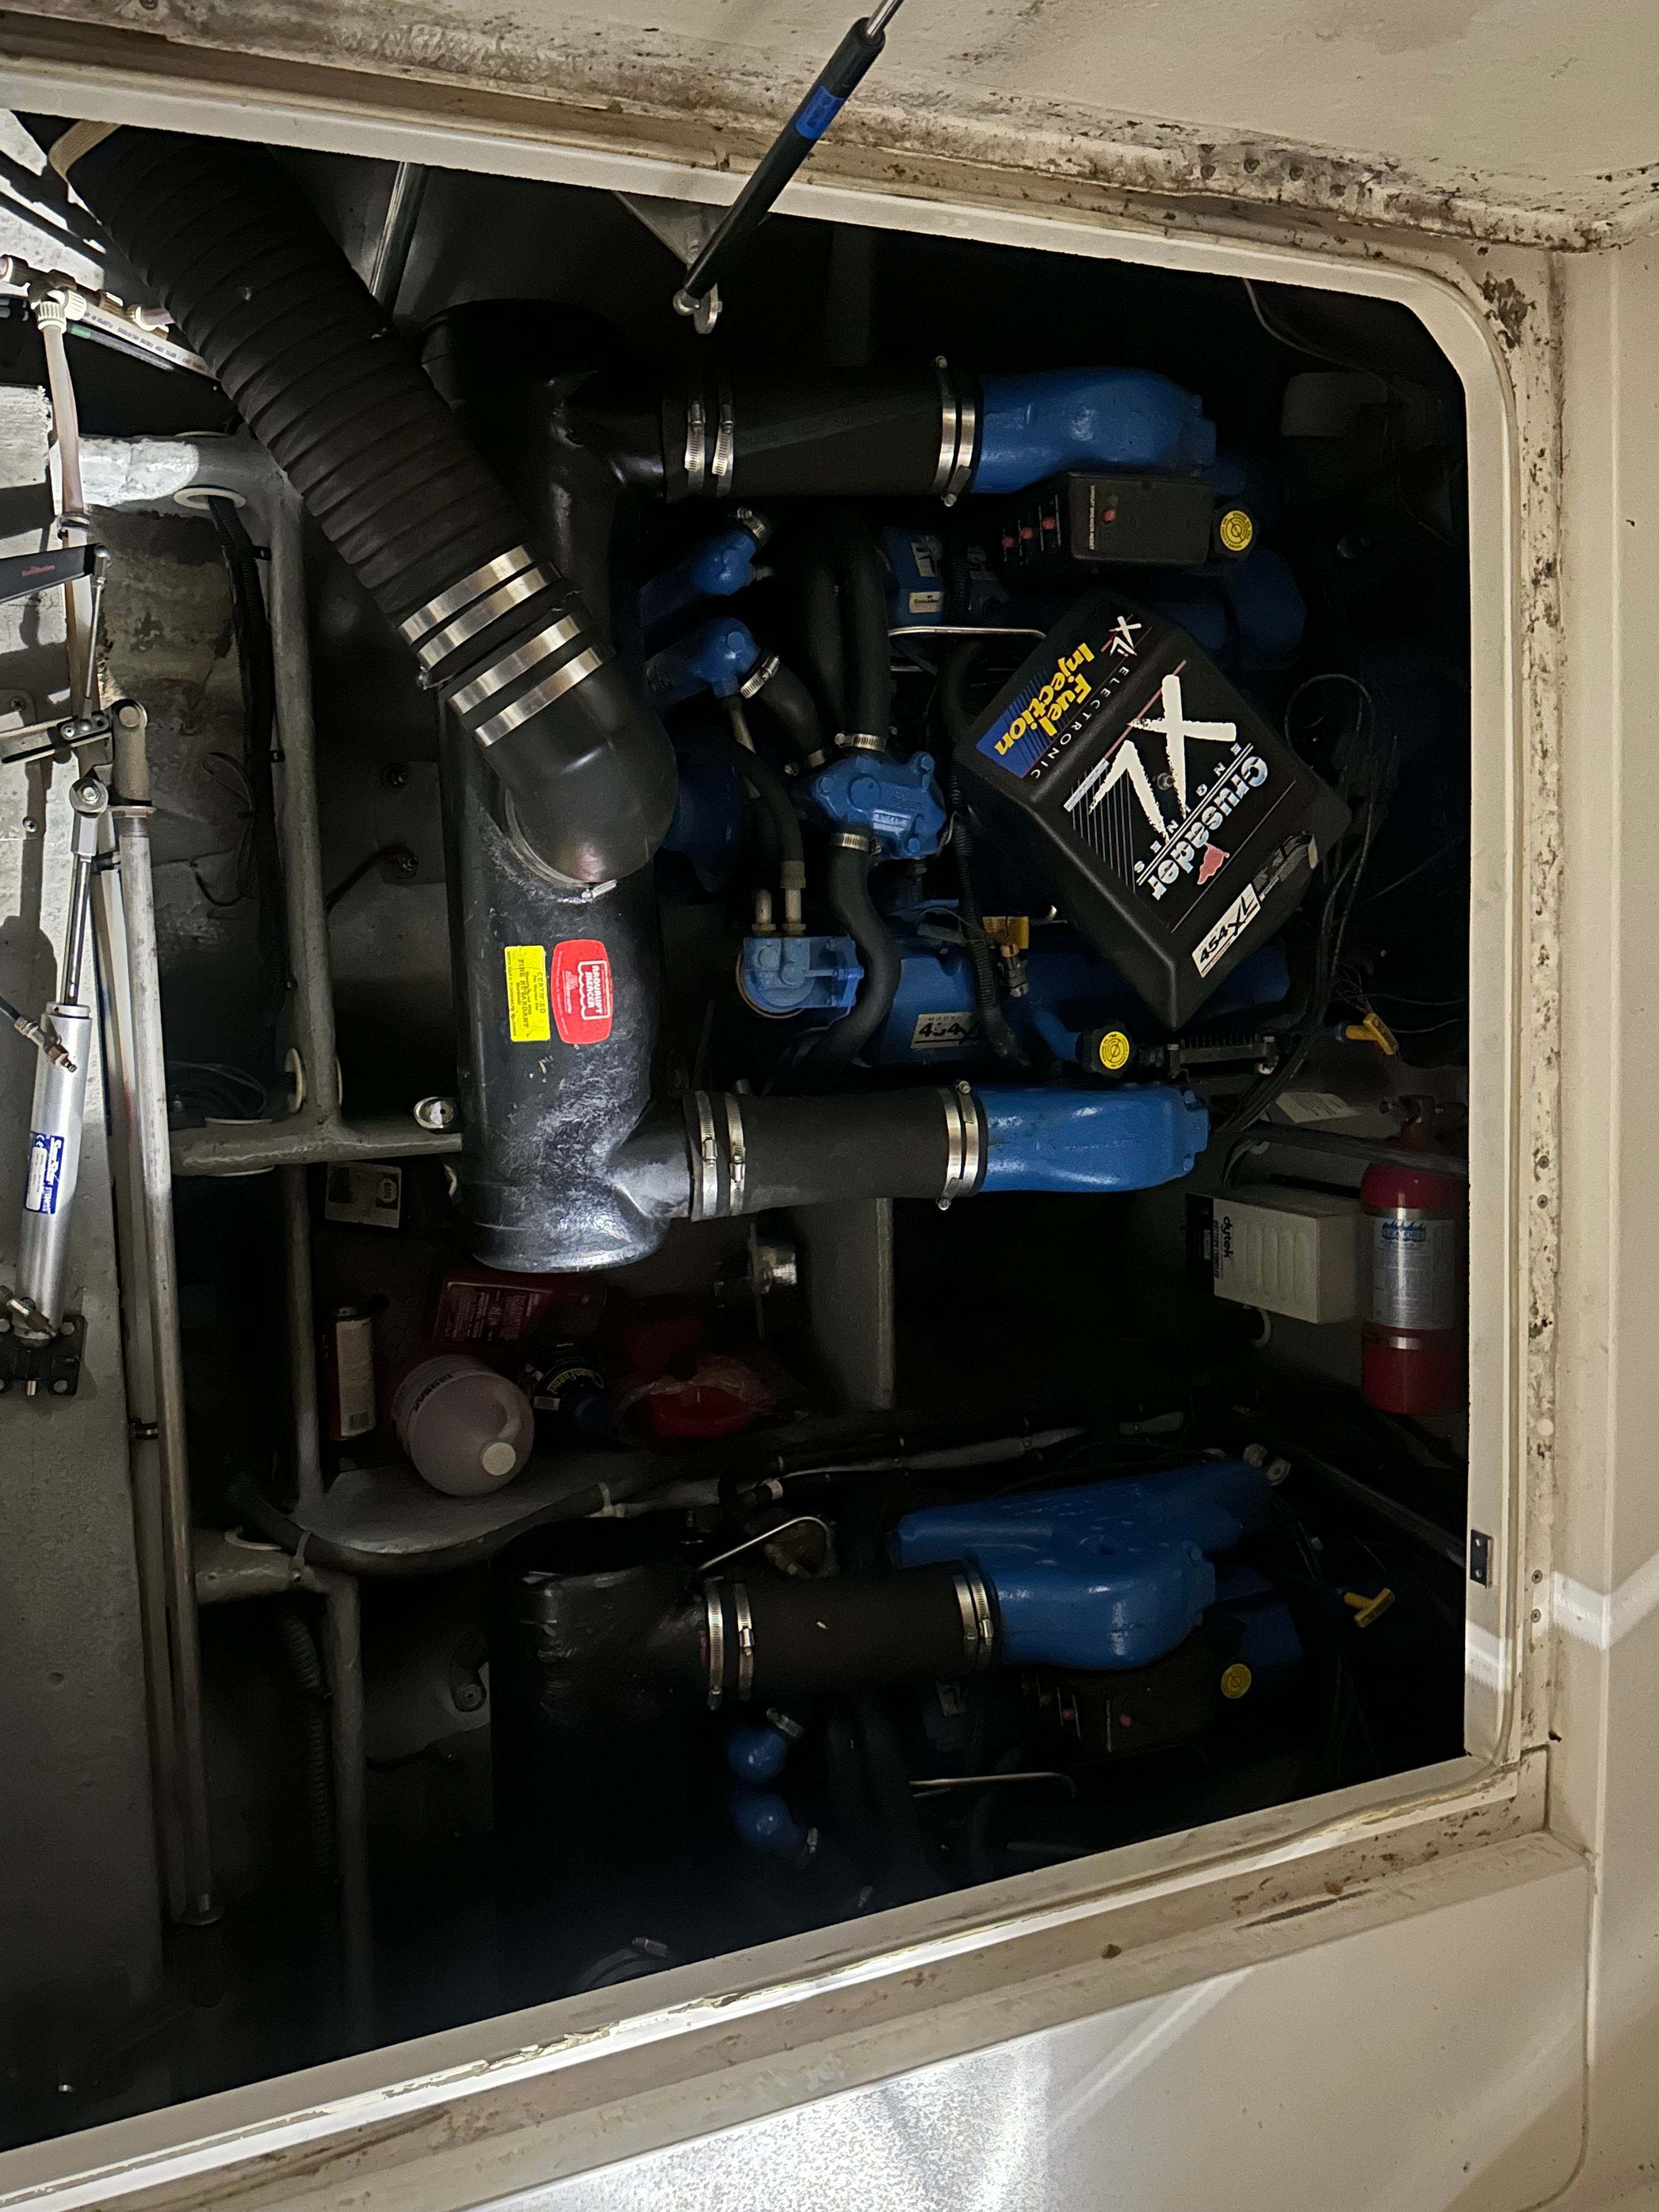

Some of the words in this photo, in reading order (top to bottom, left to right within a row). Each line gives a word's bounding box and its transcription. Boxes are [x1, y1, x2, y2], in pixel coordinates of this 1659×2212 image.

[995, 643, 1094, 755] Injection
[1031, 667, 1129, 778] ELECTRONIC
[1035, 674, 1091, 736] Fuel
[1090, 674, 1236, 844] XL
[1130, 740, 1244, 876] ENGINES
[1148, 748, 1267, 900] Crusader
[537, 972, 545, 1013] CERTIFIED
[1221, 1216, 1233, 1257] dytek
